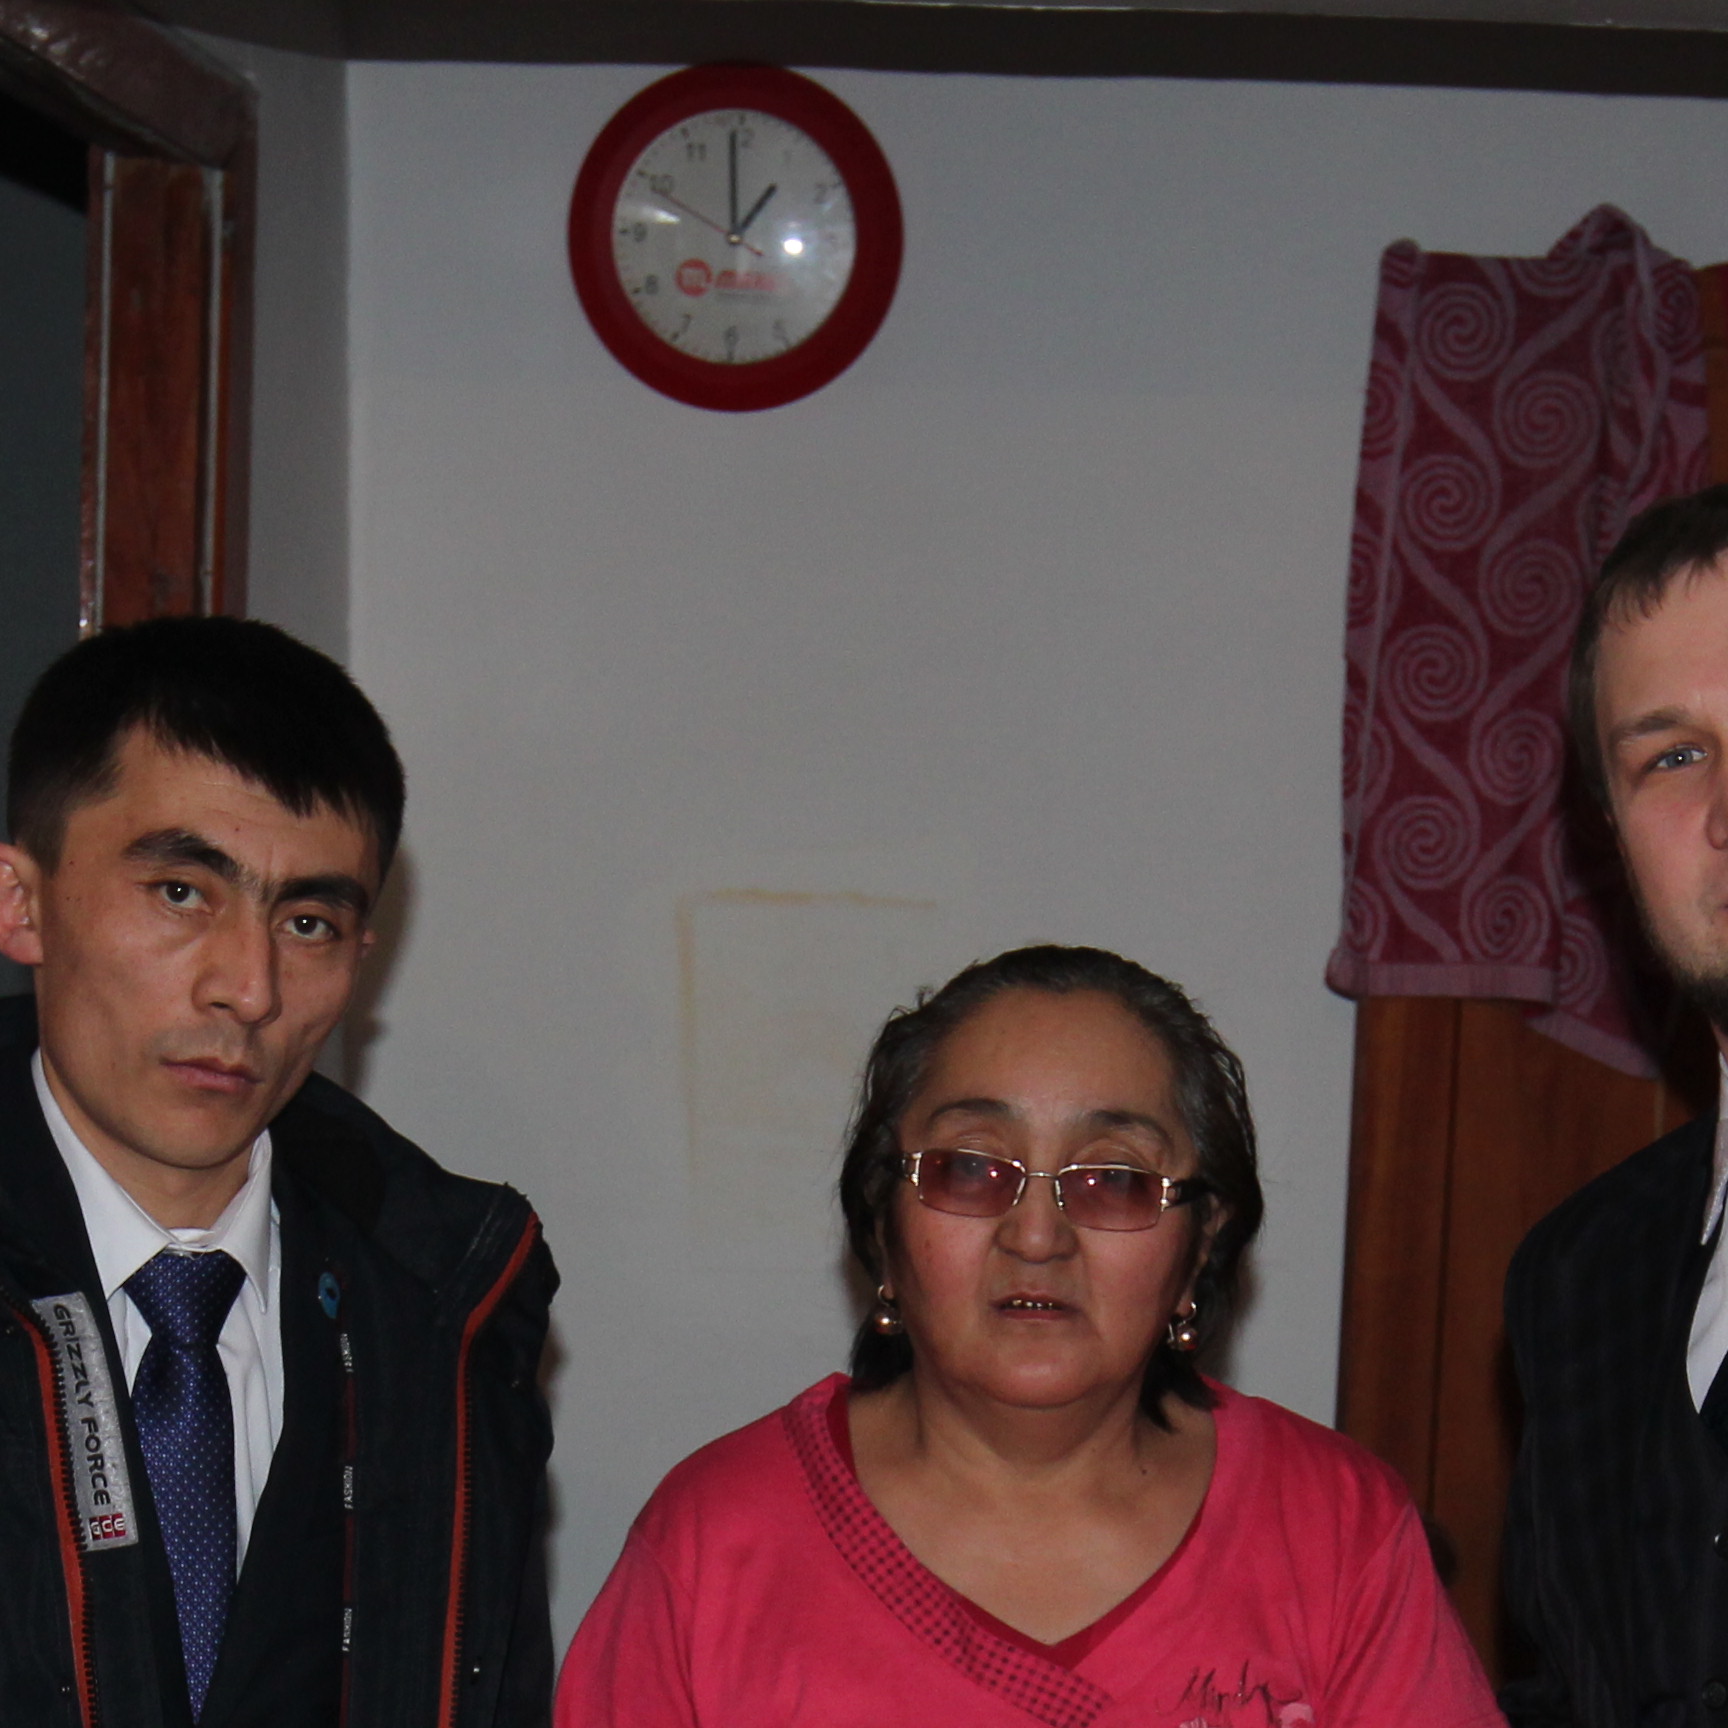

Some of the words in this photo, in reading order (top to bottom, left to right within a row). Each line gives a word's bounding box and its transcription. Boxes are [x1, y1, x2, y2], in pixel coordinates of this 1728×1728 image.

[685, 142, 707, 162] 11
[52, 1303, 94, 1408] GRIZZLY
[80, 1416, 111, 1507] FORCE
[343, 1465, 354, 1510] FASHION
[341, 1607, 352, 1652] FASHION
